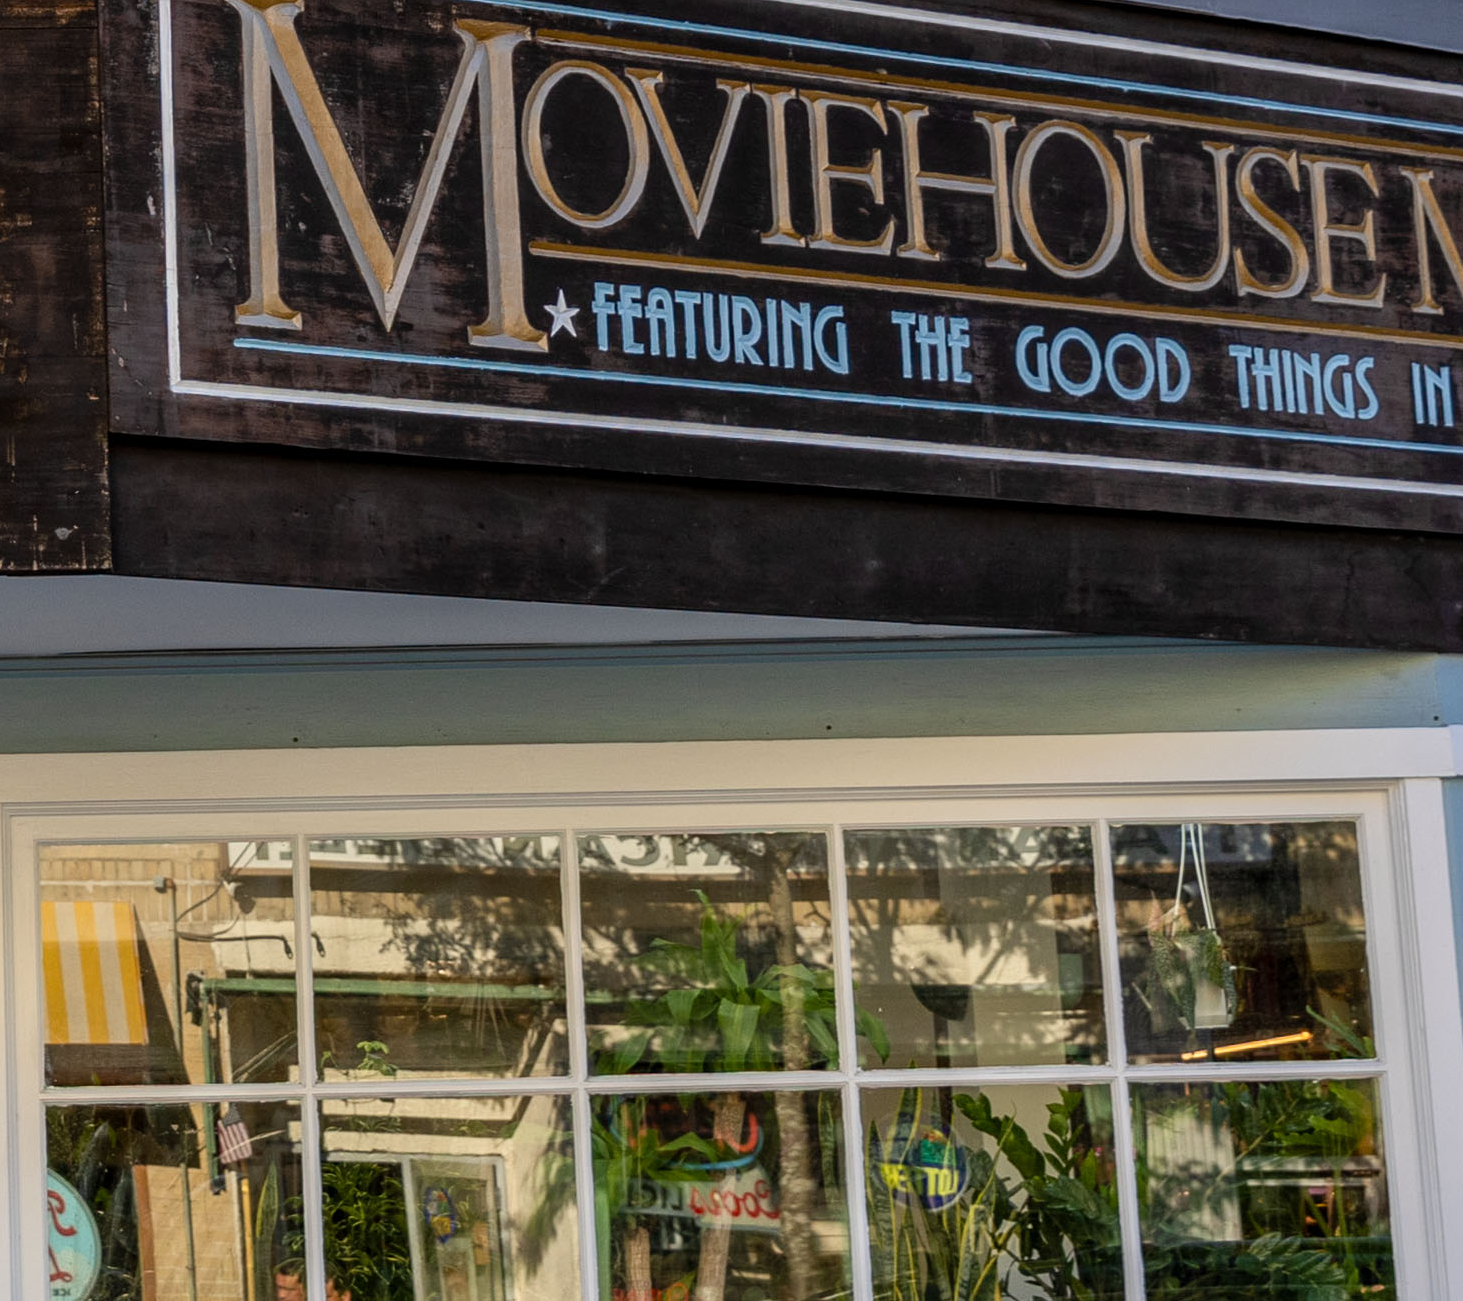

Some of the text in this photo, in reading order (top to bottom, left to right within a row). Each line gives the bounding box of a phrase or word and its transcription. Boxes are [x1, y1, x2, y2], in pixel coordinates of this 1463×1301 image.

[592, 282, 848, 375] FEATURING
[891, 310, 972, 384] THE
[1016, 324, 1191, 403] GOOD
[1229, 343, 1379, 420] THINGS
[1412, 362, 1453, 426] IN
